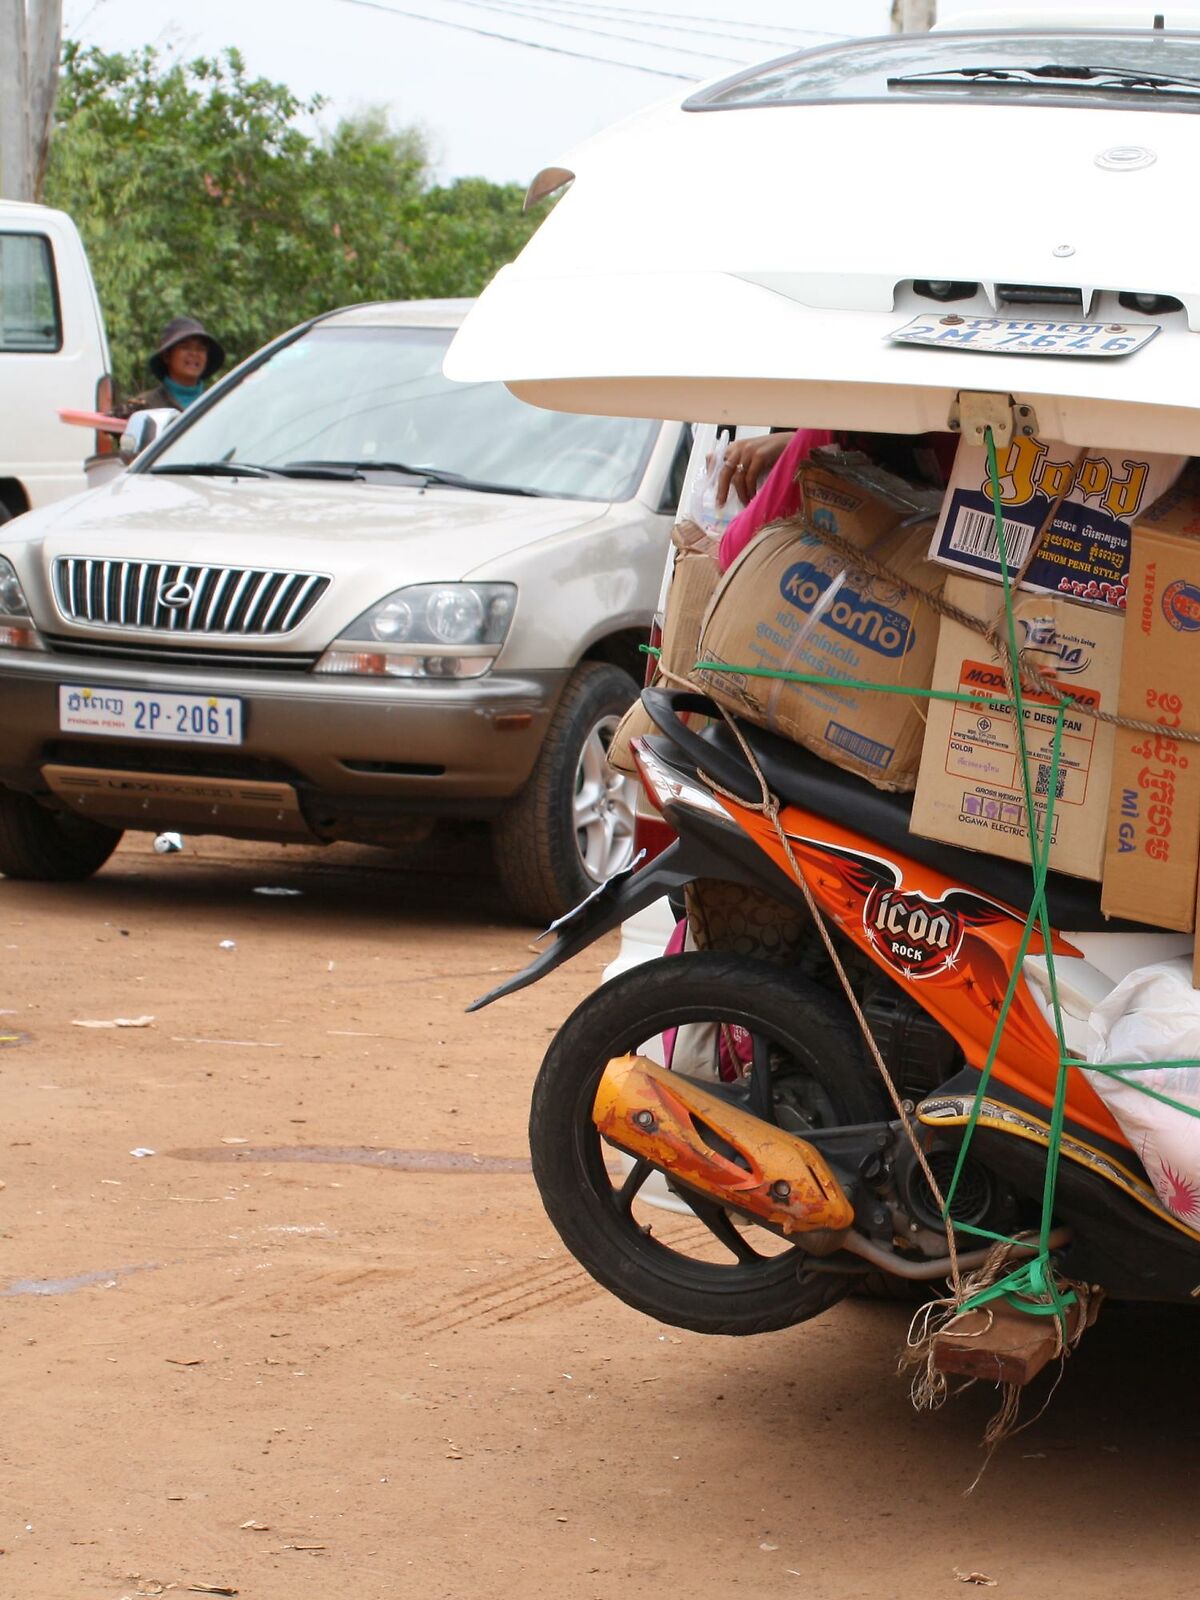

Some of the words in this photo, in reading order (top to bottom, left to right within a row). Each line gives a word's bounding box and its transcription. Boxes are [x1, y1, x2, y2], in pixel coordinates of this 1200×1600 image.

[1036, 550, 1066, 568] PHNOM
[1068, 557, 1092, 574] PENH
[1092, 564, 1121, 581] STYLE
[134, 701, 233, 736] 2P-2061
[1062, 718, 1082, 732] FAN
[950, 742, 973, 754] COLOR
[975, 786, 997, 797] GROSS
[997, 791, 1022, 802] WEIGHT
[958, 815, 988, 828] OGAWA
[991, 822, 1025, 837] ELECTRIC
[1118, 822, 1137, 853] GÀ
[891, 942, 922, 961] ROCK
